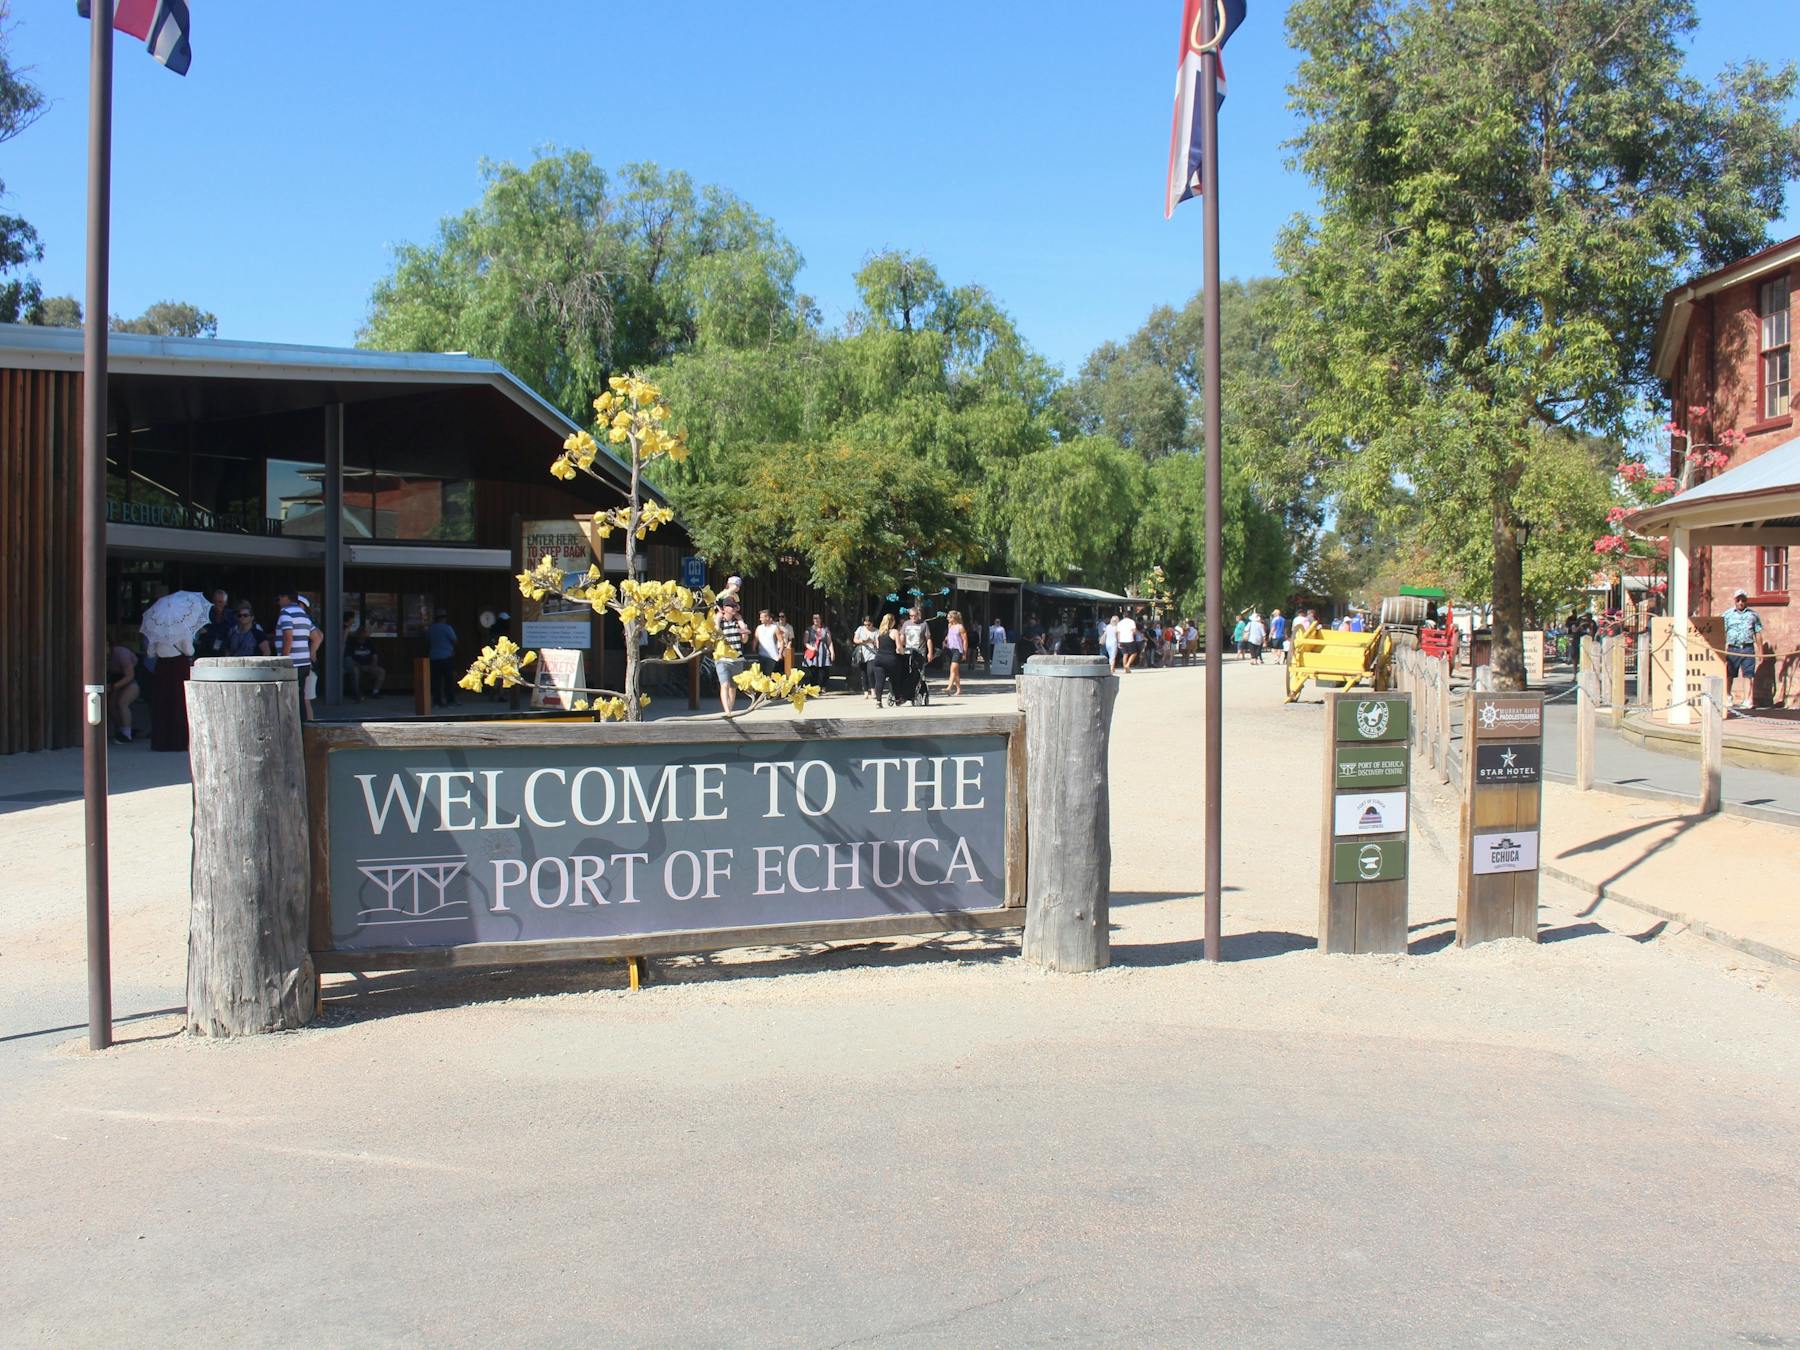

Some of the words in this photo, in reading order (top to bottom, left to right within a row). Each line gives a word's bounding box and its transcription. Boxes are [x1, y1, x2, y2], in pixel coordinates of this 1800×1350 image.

[122, 502, 178, 526] ECHUCA
[527, 534, 554, 546] ENTER
[556, 534, 578, 546] HERE
[527, 546, 540, 558] TO
[540, 545, 561, 558] STEP
[564, 545, 586, 557] BACK
[527, 558, 536, 570] IN
[540, 661, 576, 673] TICKETS
[1499, 713, 1539, 721] PADDLESTEAMERS
[1382, 760, 1404, 768] ECHUCA
[1358, 768, 1384, 776] DISCOVERY
[1385, 767, 1403, 775] CENTRE
[1480, 768, 1503, 776] STAR
[1507, 767, 1536, 775] HOTEL
[353, 763, 728, 835] WELCOME
[753, 759, 836, 818] TO
[861, 755, 985, 814] THE
[1491, 850, 1520, 863] ECHUCA
[489, 852, 649, 912] PORT
[663, 848, 734, 901] OF
[752, 836, 984, 895] ECHUCA
